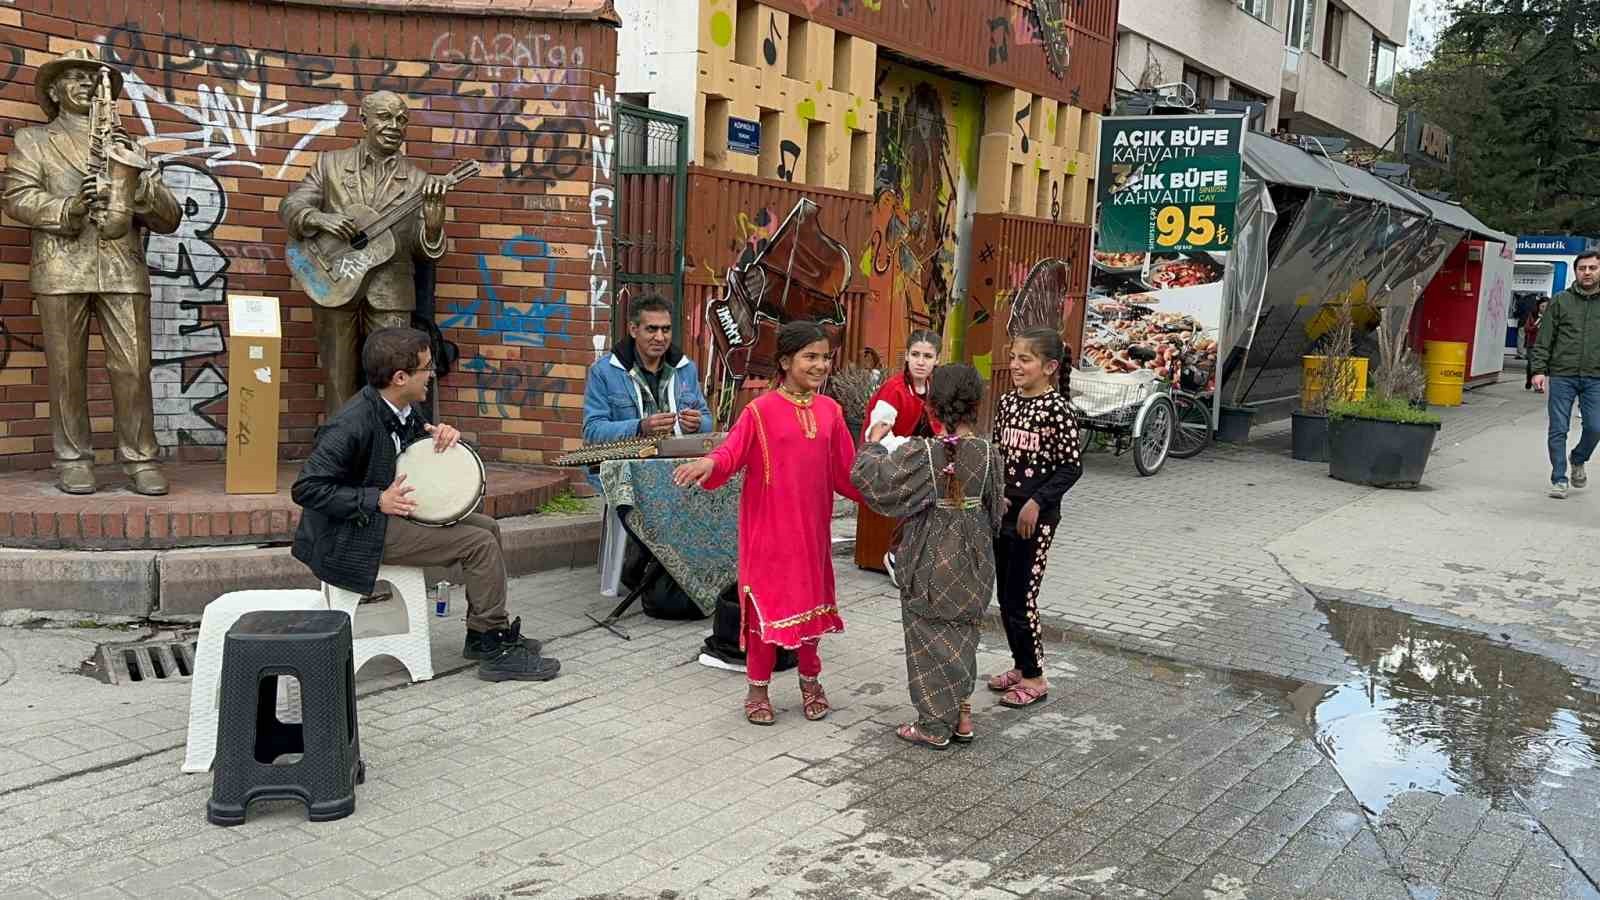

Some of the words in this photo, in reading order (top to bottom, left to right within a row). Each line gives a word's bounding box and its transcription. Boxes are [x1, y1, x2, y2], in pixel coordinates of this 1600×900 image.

[1113, 130, 1166, 149] AÇIK
[1170, 126, 1229, 146] BÜFE
[1169, 168, 1228, 189] BÜFE
[1113, 189, 1195, 206] KAHVALTI
[1001, 427, 1040, 452] OWER
